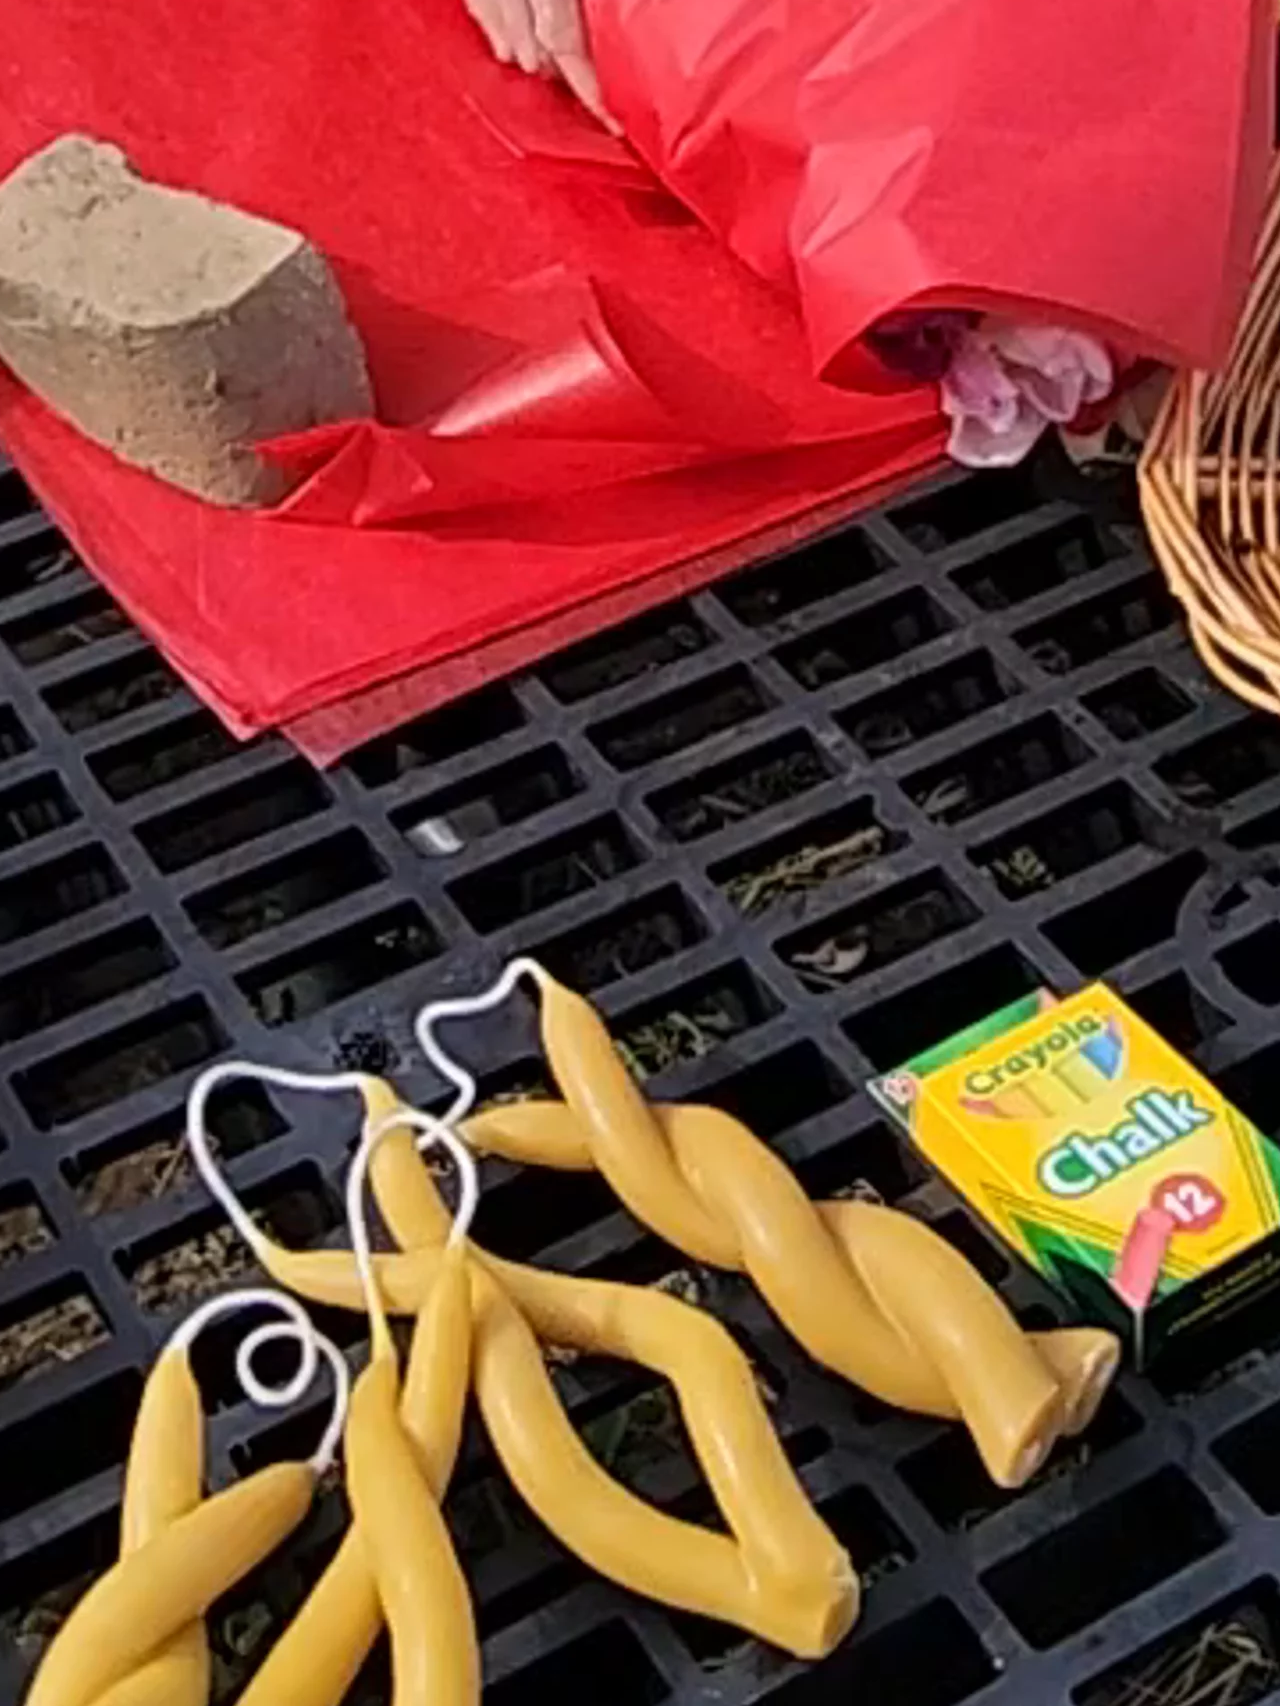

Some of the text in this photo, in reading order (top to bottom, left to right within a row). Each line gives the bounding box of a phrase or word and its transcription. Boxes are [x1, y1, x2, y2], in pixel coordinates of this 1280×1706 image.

[964, 1010, 1103, 1098] Crayola
[1037, 1087, 1217, 1200] Chalk
[1163, 1182, 1218, 1224] 12
